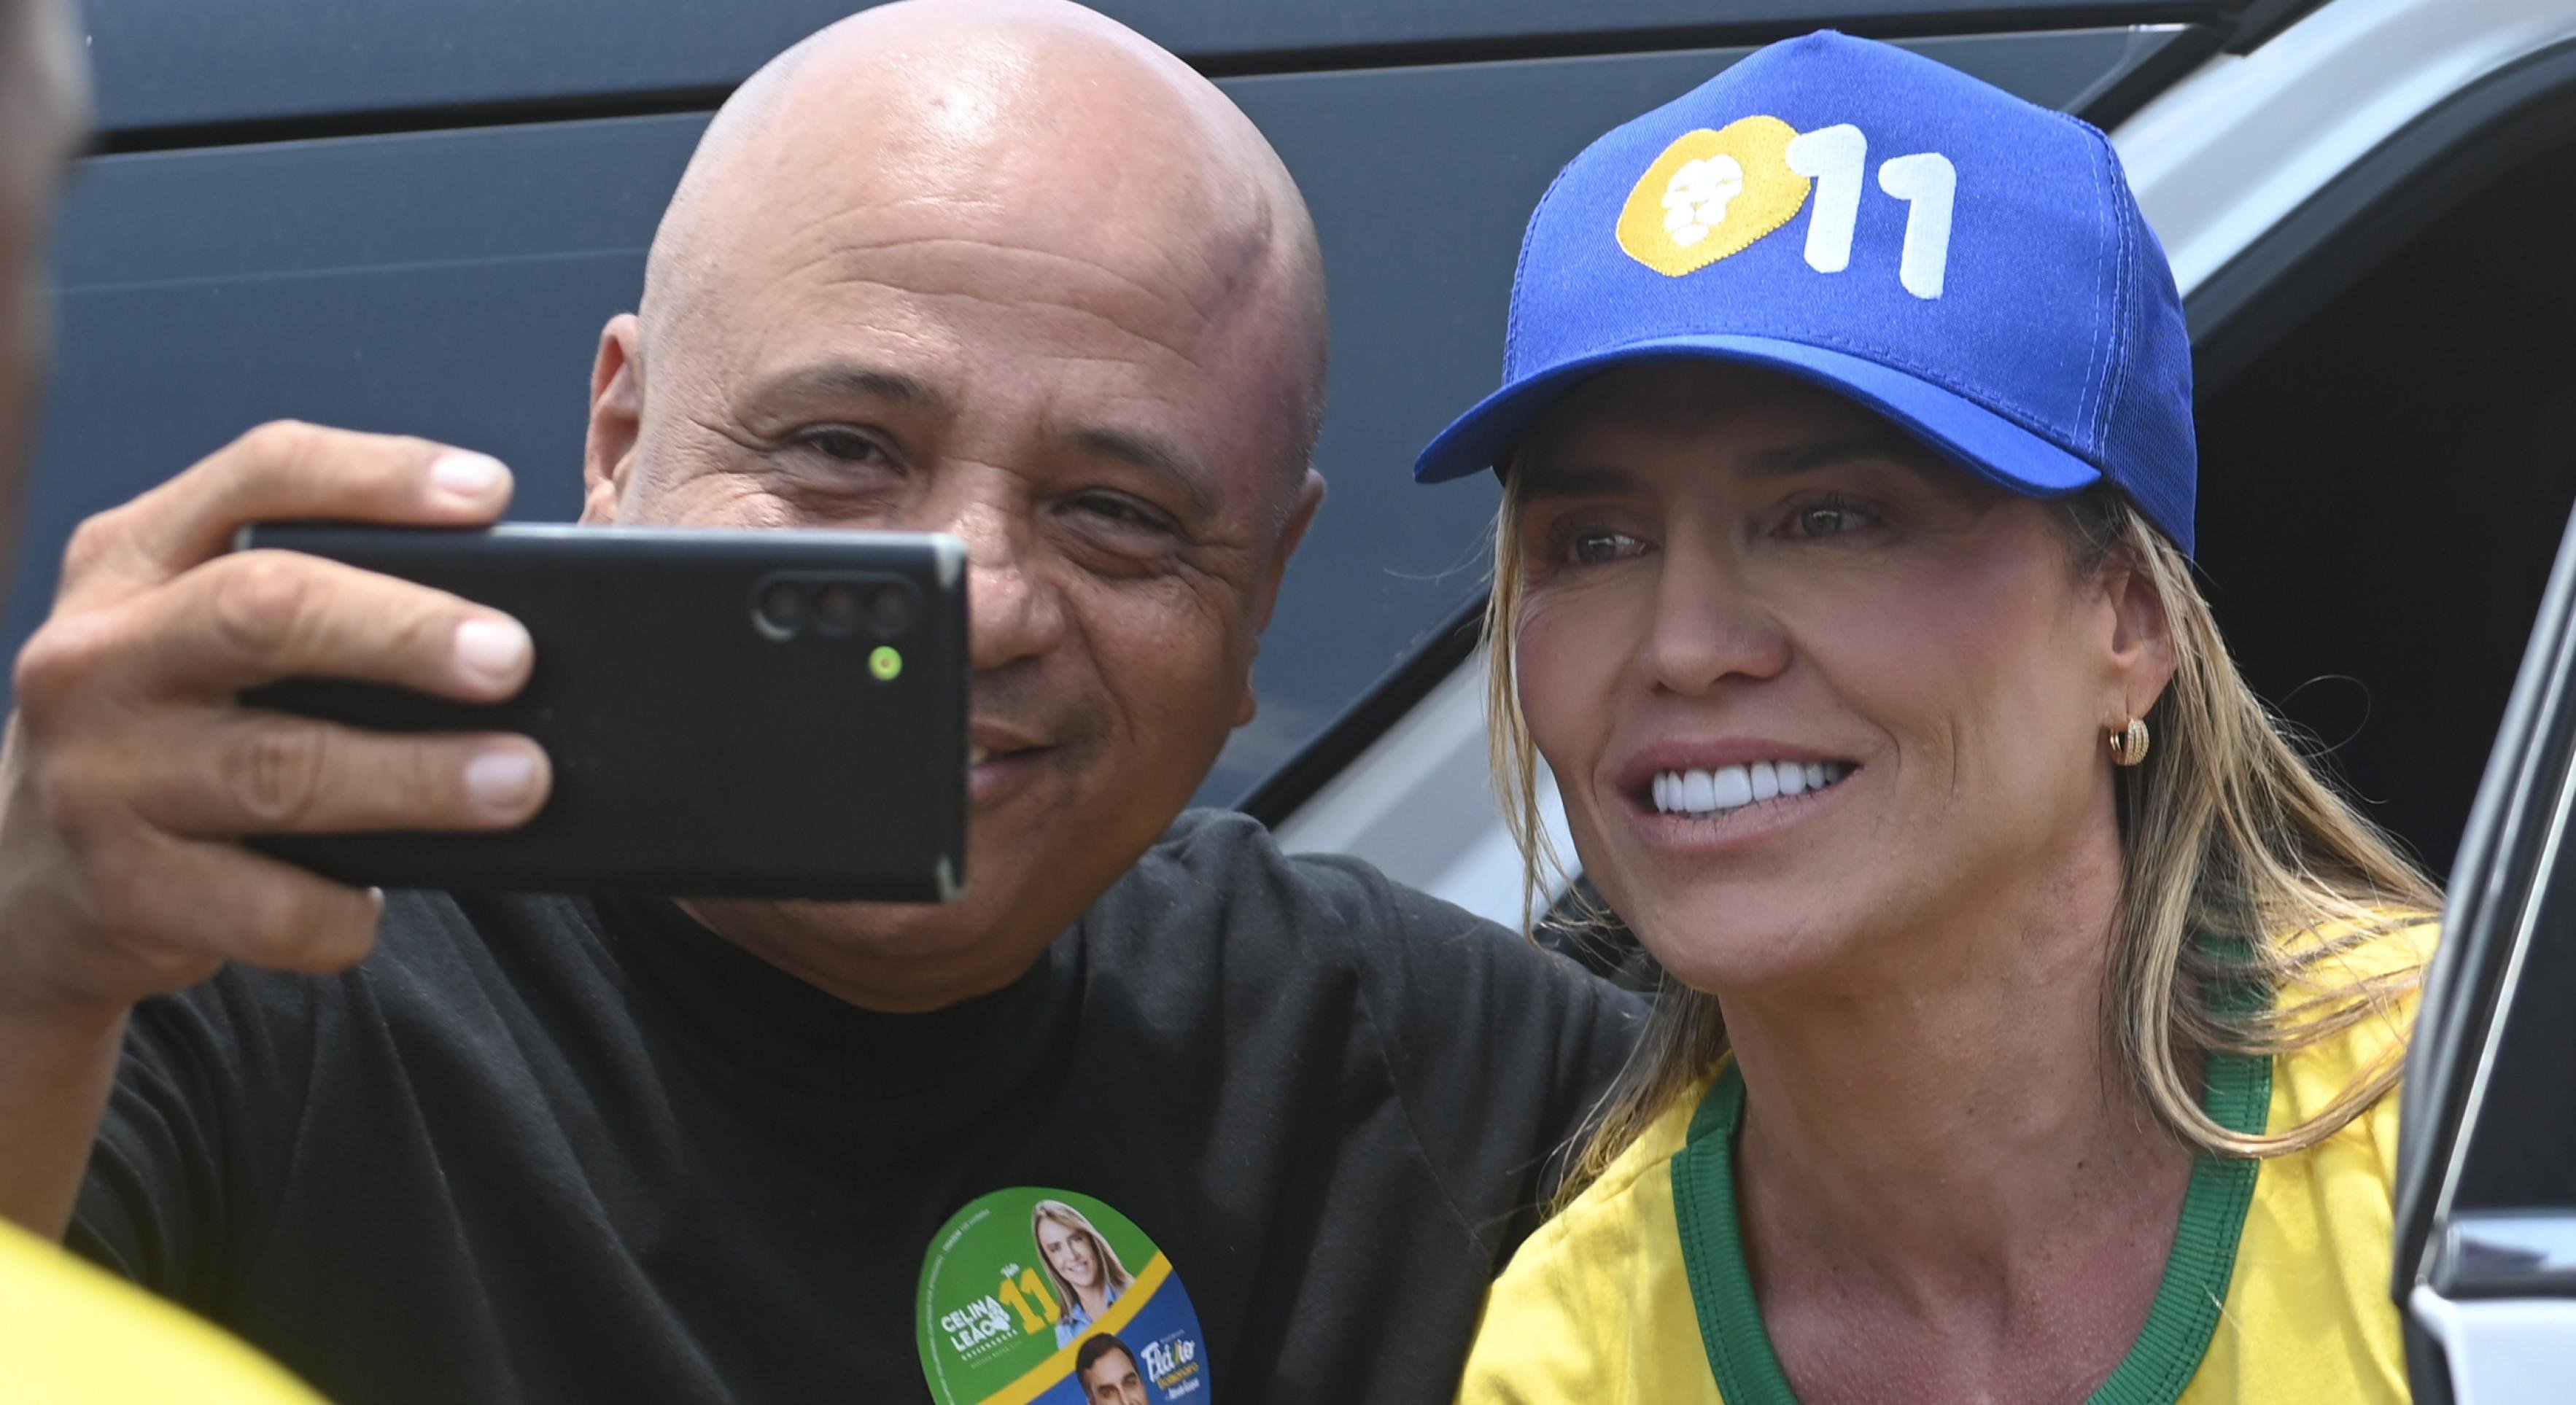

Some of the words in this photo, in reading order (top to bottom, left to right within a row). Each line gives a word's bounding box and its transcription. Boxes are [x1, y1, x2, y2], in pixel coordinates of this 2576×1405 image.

[1786, 123, 1957, 300] 11
[941, 1295, 1001, 1333] CELINA
[999, 1266, 1060, 1334] 11
